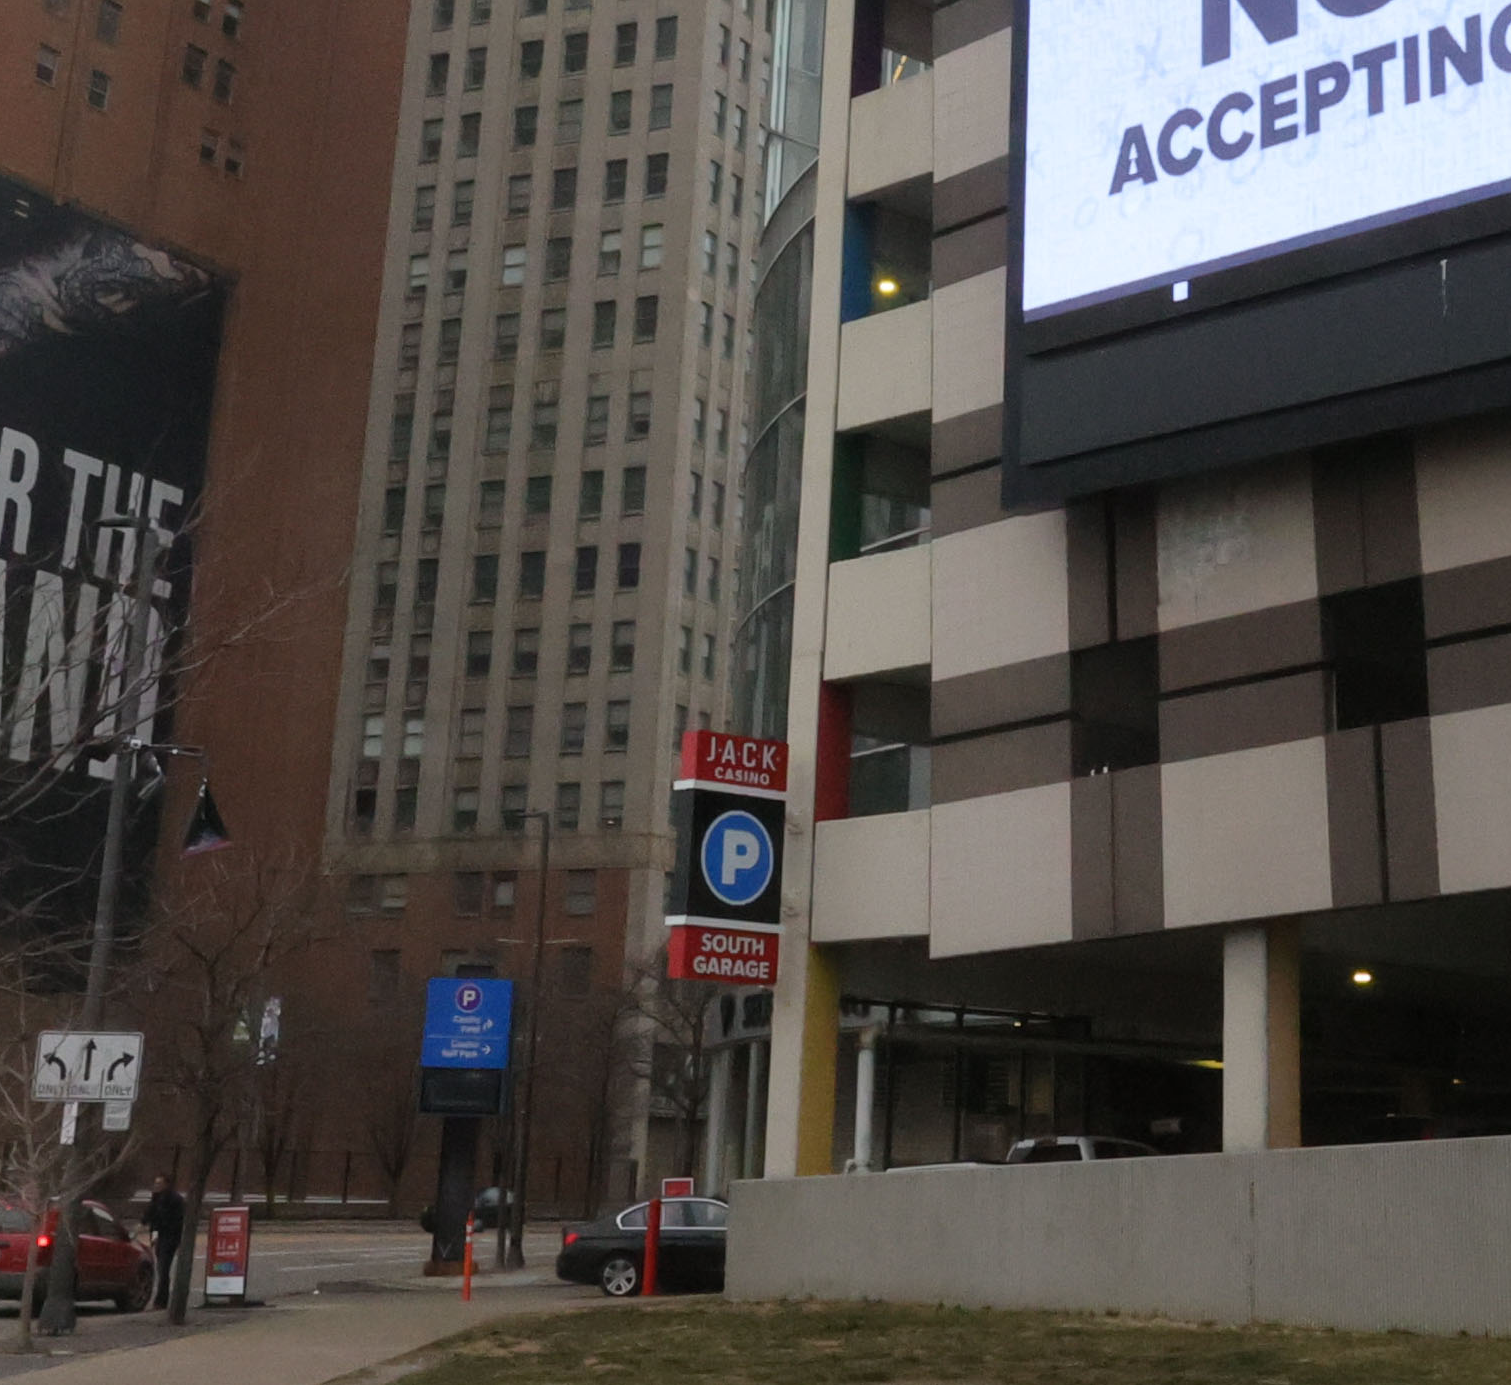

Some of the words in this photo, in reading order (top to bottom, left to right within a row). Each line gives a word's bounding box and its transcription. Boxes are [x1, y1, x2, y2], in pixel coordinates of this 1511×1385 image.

[62, 447, 185, 600] THE
[714, 766, 770, 786] CASINO
[721, 828, 760, 886] P
[701, 933, 765, 957] SOUTH
[692, 955, 770, 979] GARAGE
[104, 1085, 132, 1096] ONLY
